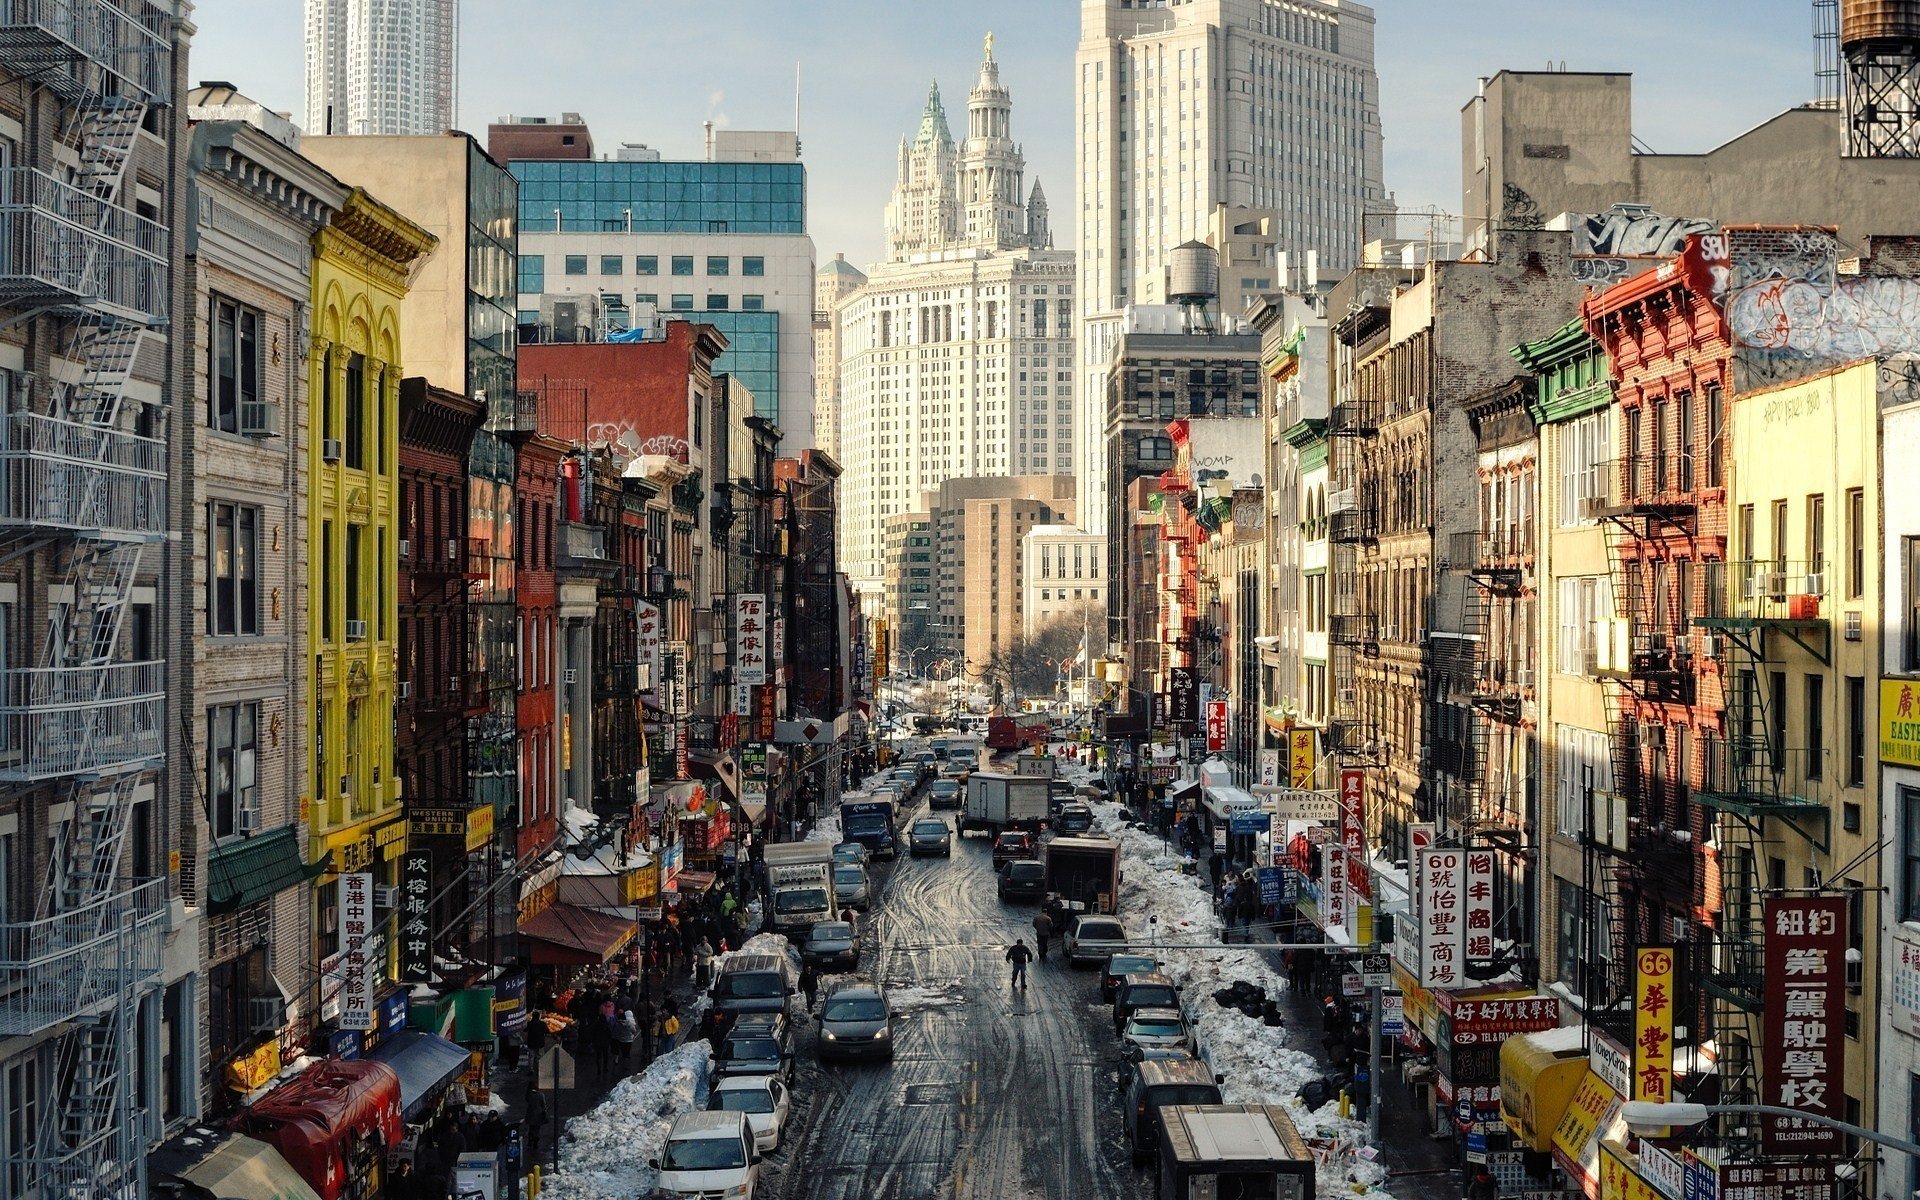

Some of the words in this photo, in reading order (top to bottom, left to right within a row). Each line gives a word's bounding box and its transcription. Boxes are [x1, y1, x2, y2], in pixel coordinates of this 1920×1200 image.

[406, 857, 428, 975] 欣榕服務中心
[1775, 909, 1836, 936] 紐約
[345, 876, 366, 1010] 香港中醫骨傷科診所
[1641, 953, 1669, 975] 66
[1454, 1000, 1558, 1021] 好好駕駛學校
[1456, 1034, 1475, 1044] 62
[1780, 948, 1829, 1109] 第一駕駛學校
